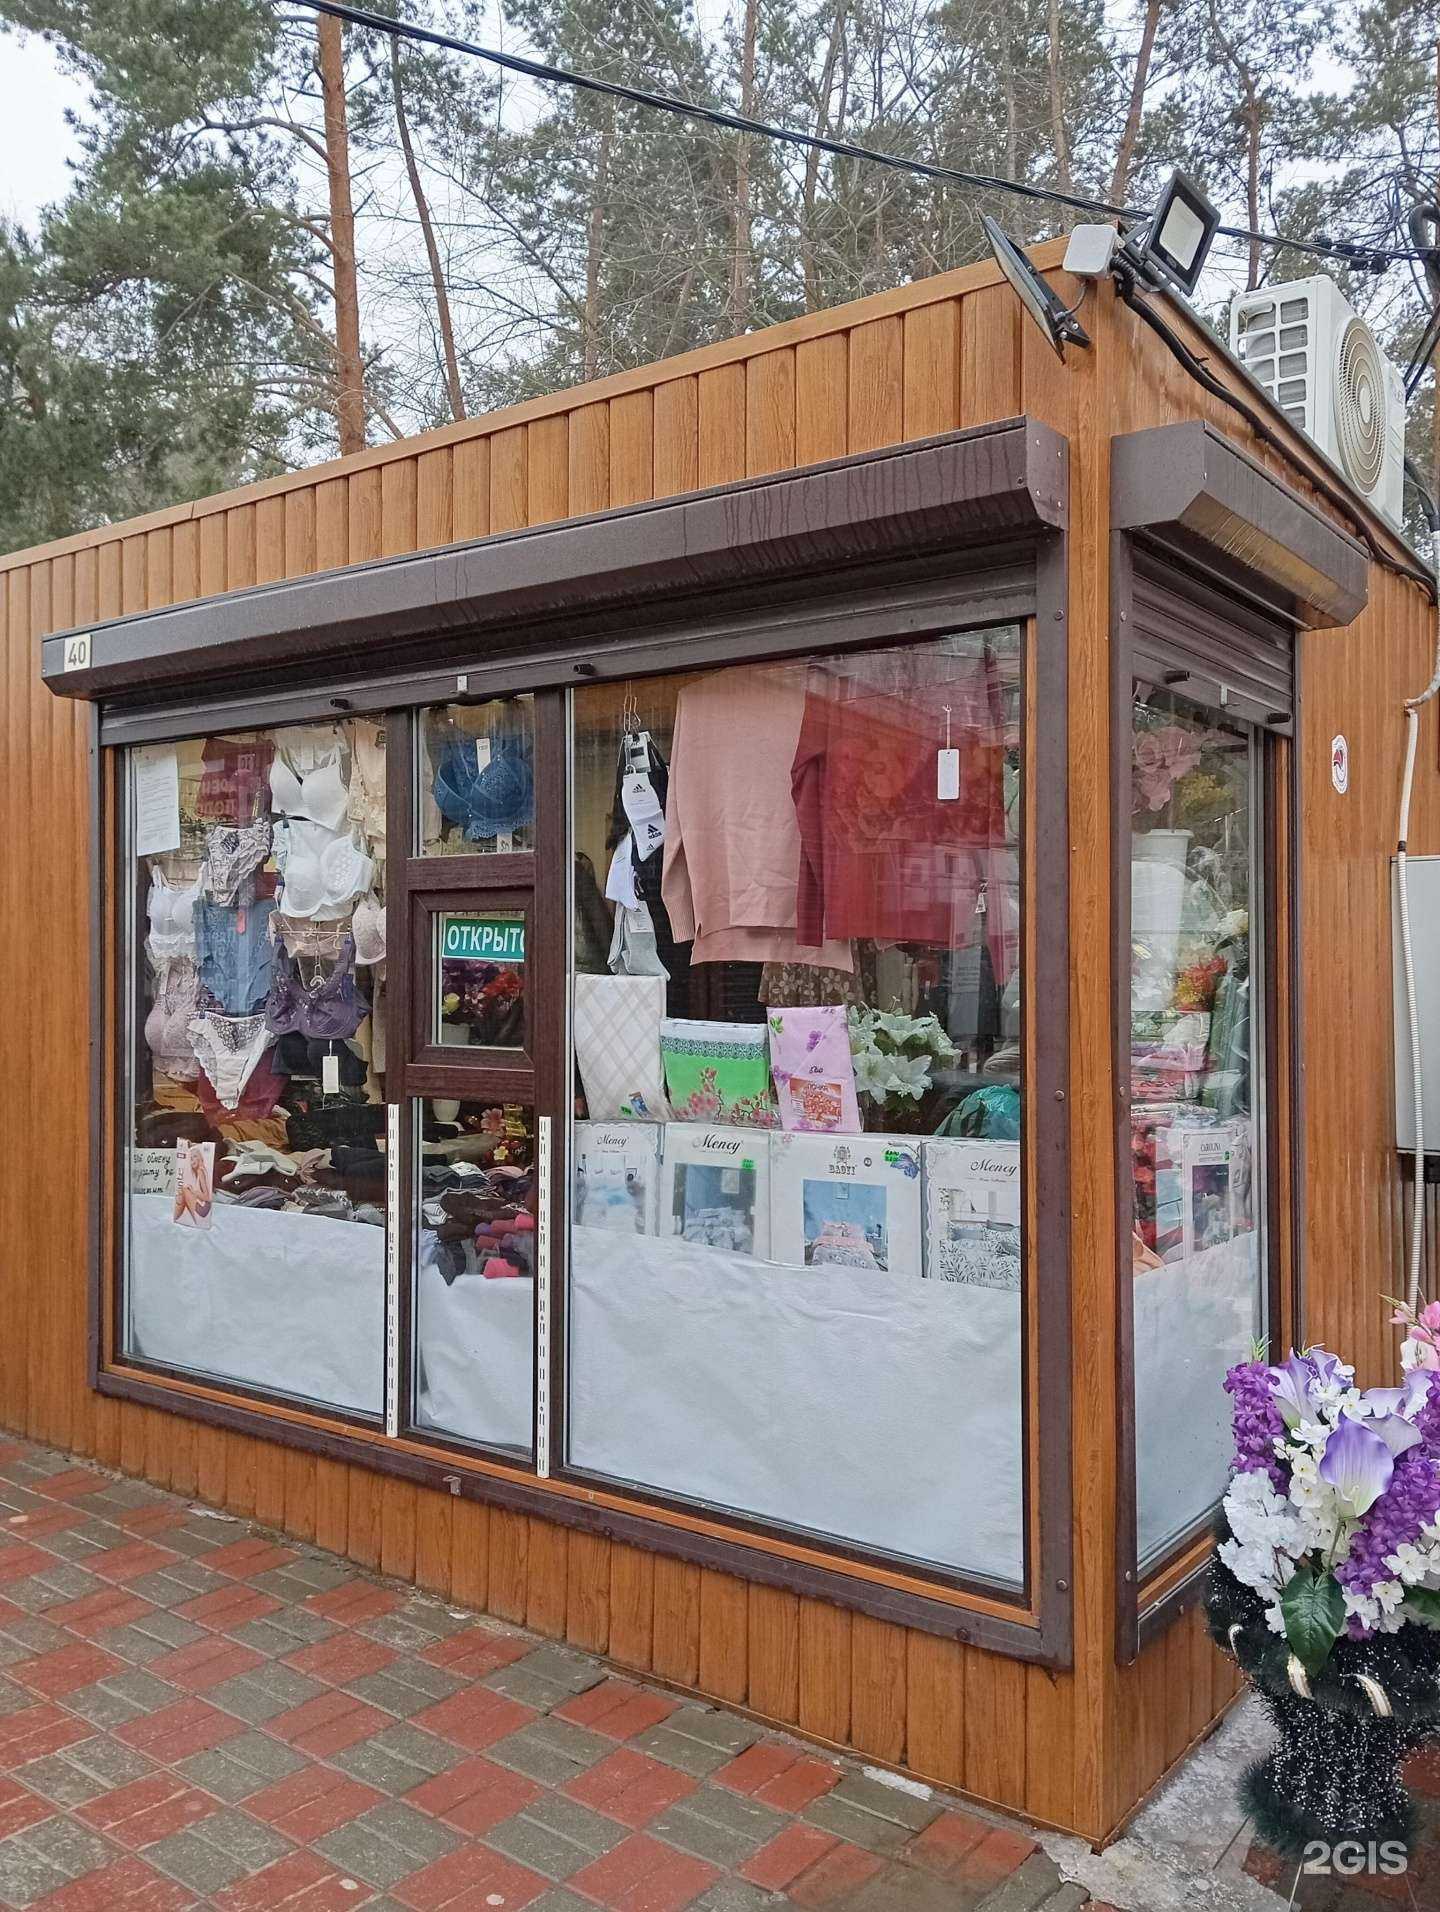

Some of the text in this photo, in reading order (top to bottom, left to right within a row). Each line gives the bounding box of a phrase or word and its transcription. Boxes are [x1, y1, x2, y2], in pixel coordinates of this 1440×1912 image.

[68, 641, 87, 666] 40
[597, 1134, 628, 1147] Mency
[692, 1134, 741, 1155] Mency
[970, 1159, 1018, 1177] Mency
